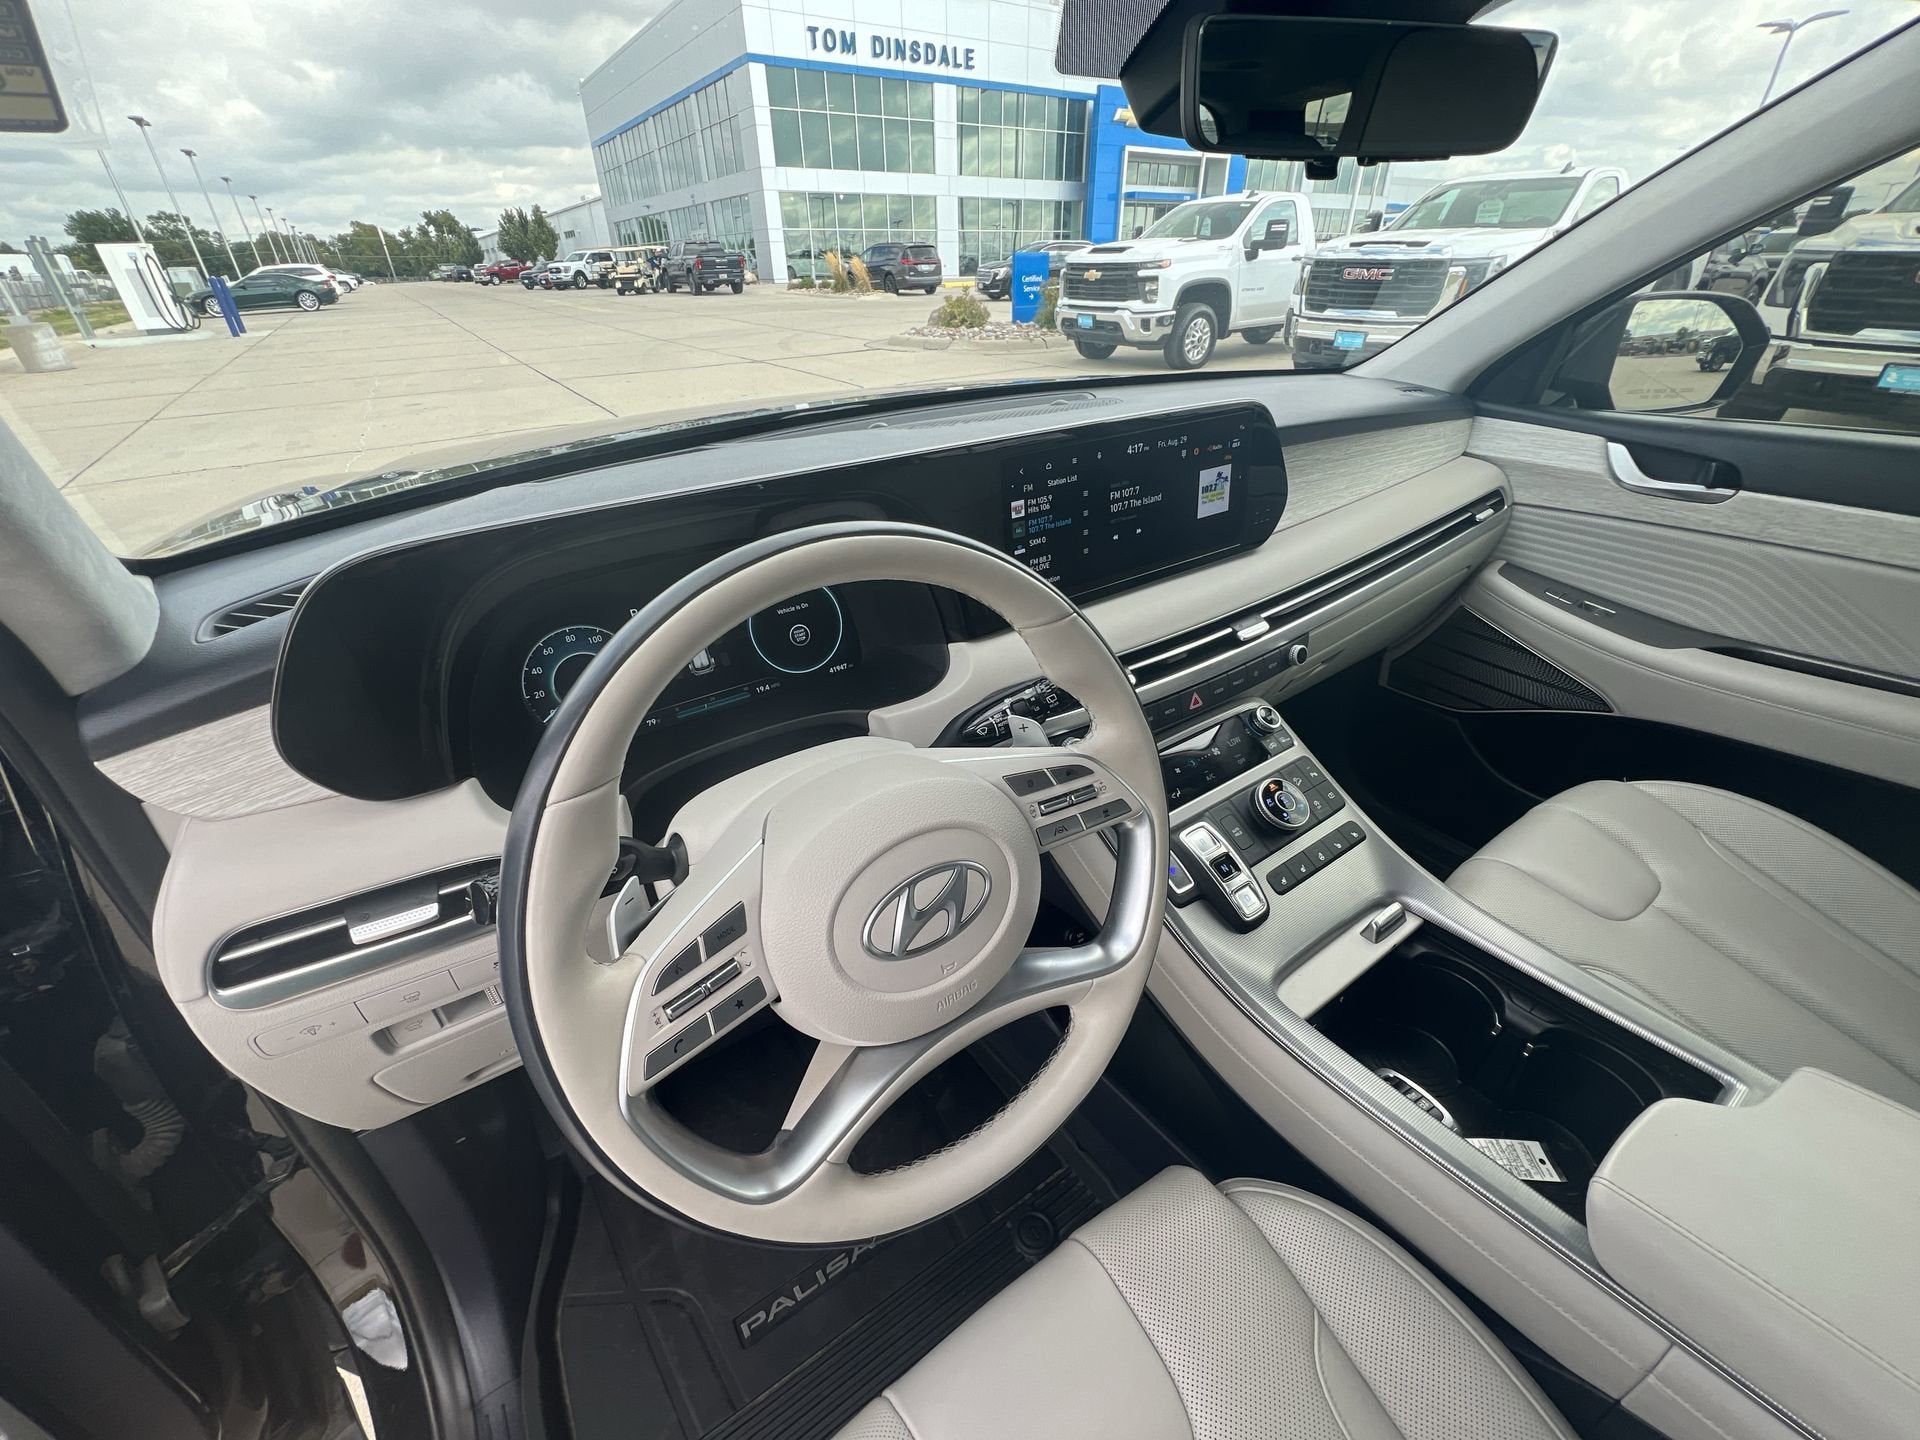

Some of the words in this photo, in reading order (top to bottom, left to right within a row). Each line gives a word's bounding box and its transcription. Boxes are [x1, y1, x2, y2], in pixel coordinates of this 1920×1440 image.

[807, 26, 857, 55] TOM
[871, 35, 975, 70] DINSDALE
[1021, 274, 1043, 283] Certified
[1343, 267, 1395, 281] GMC
[1180, 435, 1187, 444] 29
[1127, 443, 1143, 455] 4:17
[1047, 477, 1066, 487] Station
[1067, 474, 1077, 483] List
[1023, 483, 1033, 492] FM
[1110, 491, 1120, 500] FM
[1121, 486, 1140, 498] 107.7
[1037, 494, 1052, 504] 105.9
[1110, 500, 1128, 512] 107.7
[1130, 498, 1142, 507] The
[1142, 492, 1162, 505] Island
[1027, 506, 1039, 514] Hits
[1040, 503, 1050, 511] 106
[1038, 514, 1053, 524] 107.7
[1028, 524, 1044, 534] 107.7
[1055, 517, 1072, 528] Island
[1029, 538, 1041, 547] SXM
[776, 605, 795, 615] Vehicle
[565, 634, 576, 643] 80
[588, 634, 602, 644] 100
[543, 646, 554, 656] 60
[531, 666, 543, 675] 40
[829, 663, 847, 673] 41947
[756, 684, 770, 693] 19.4
[533, 690, 545, 699] 20
[646, 718, 656, 726] 79
[937, 979, 978, 1013] AIRBAG
[740, 1240, 878, 1339] PALISA
